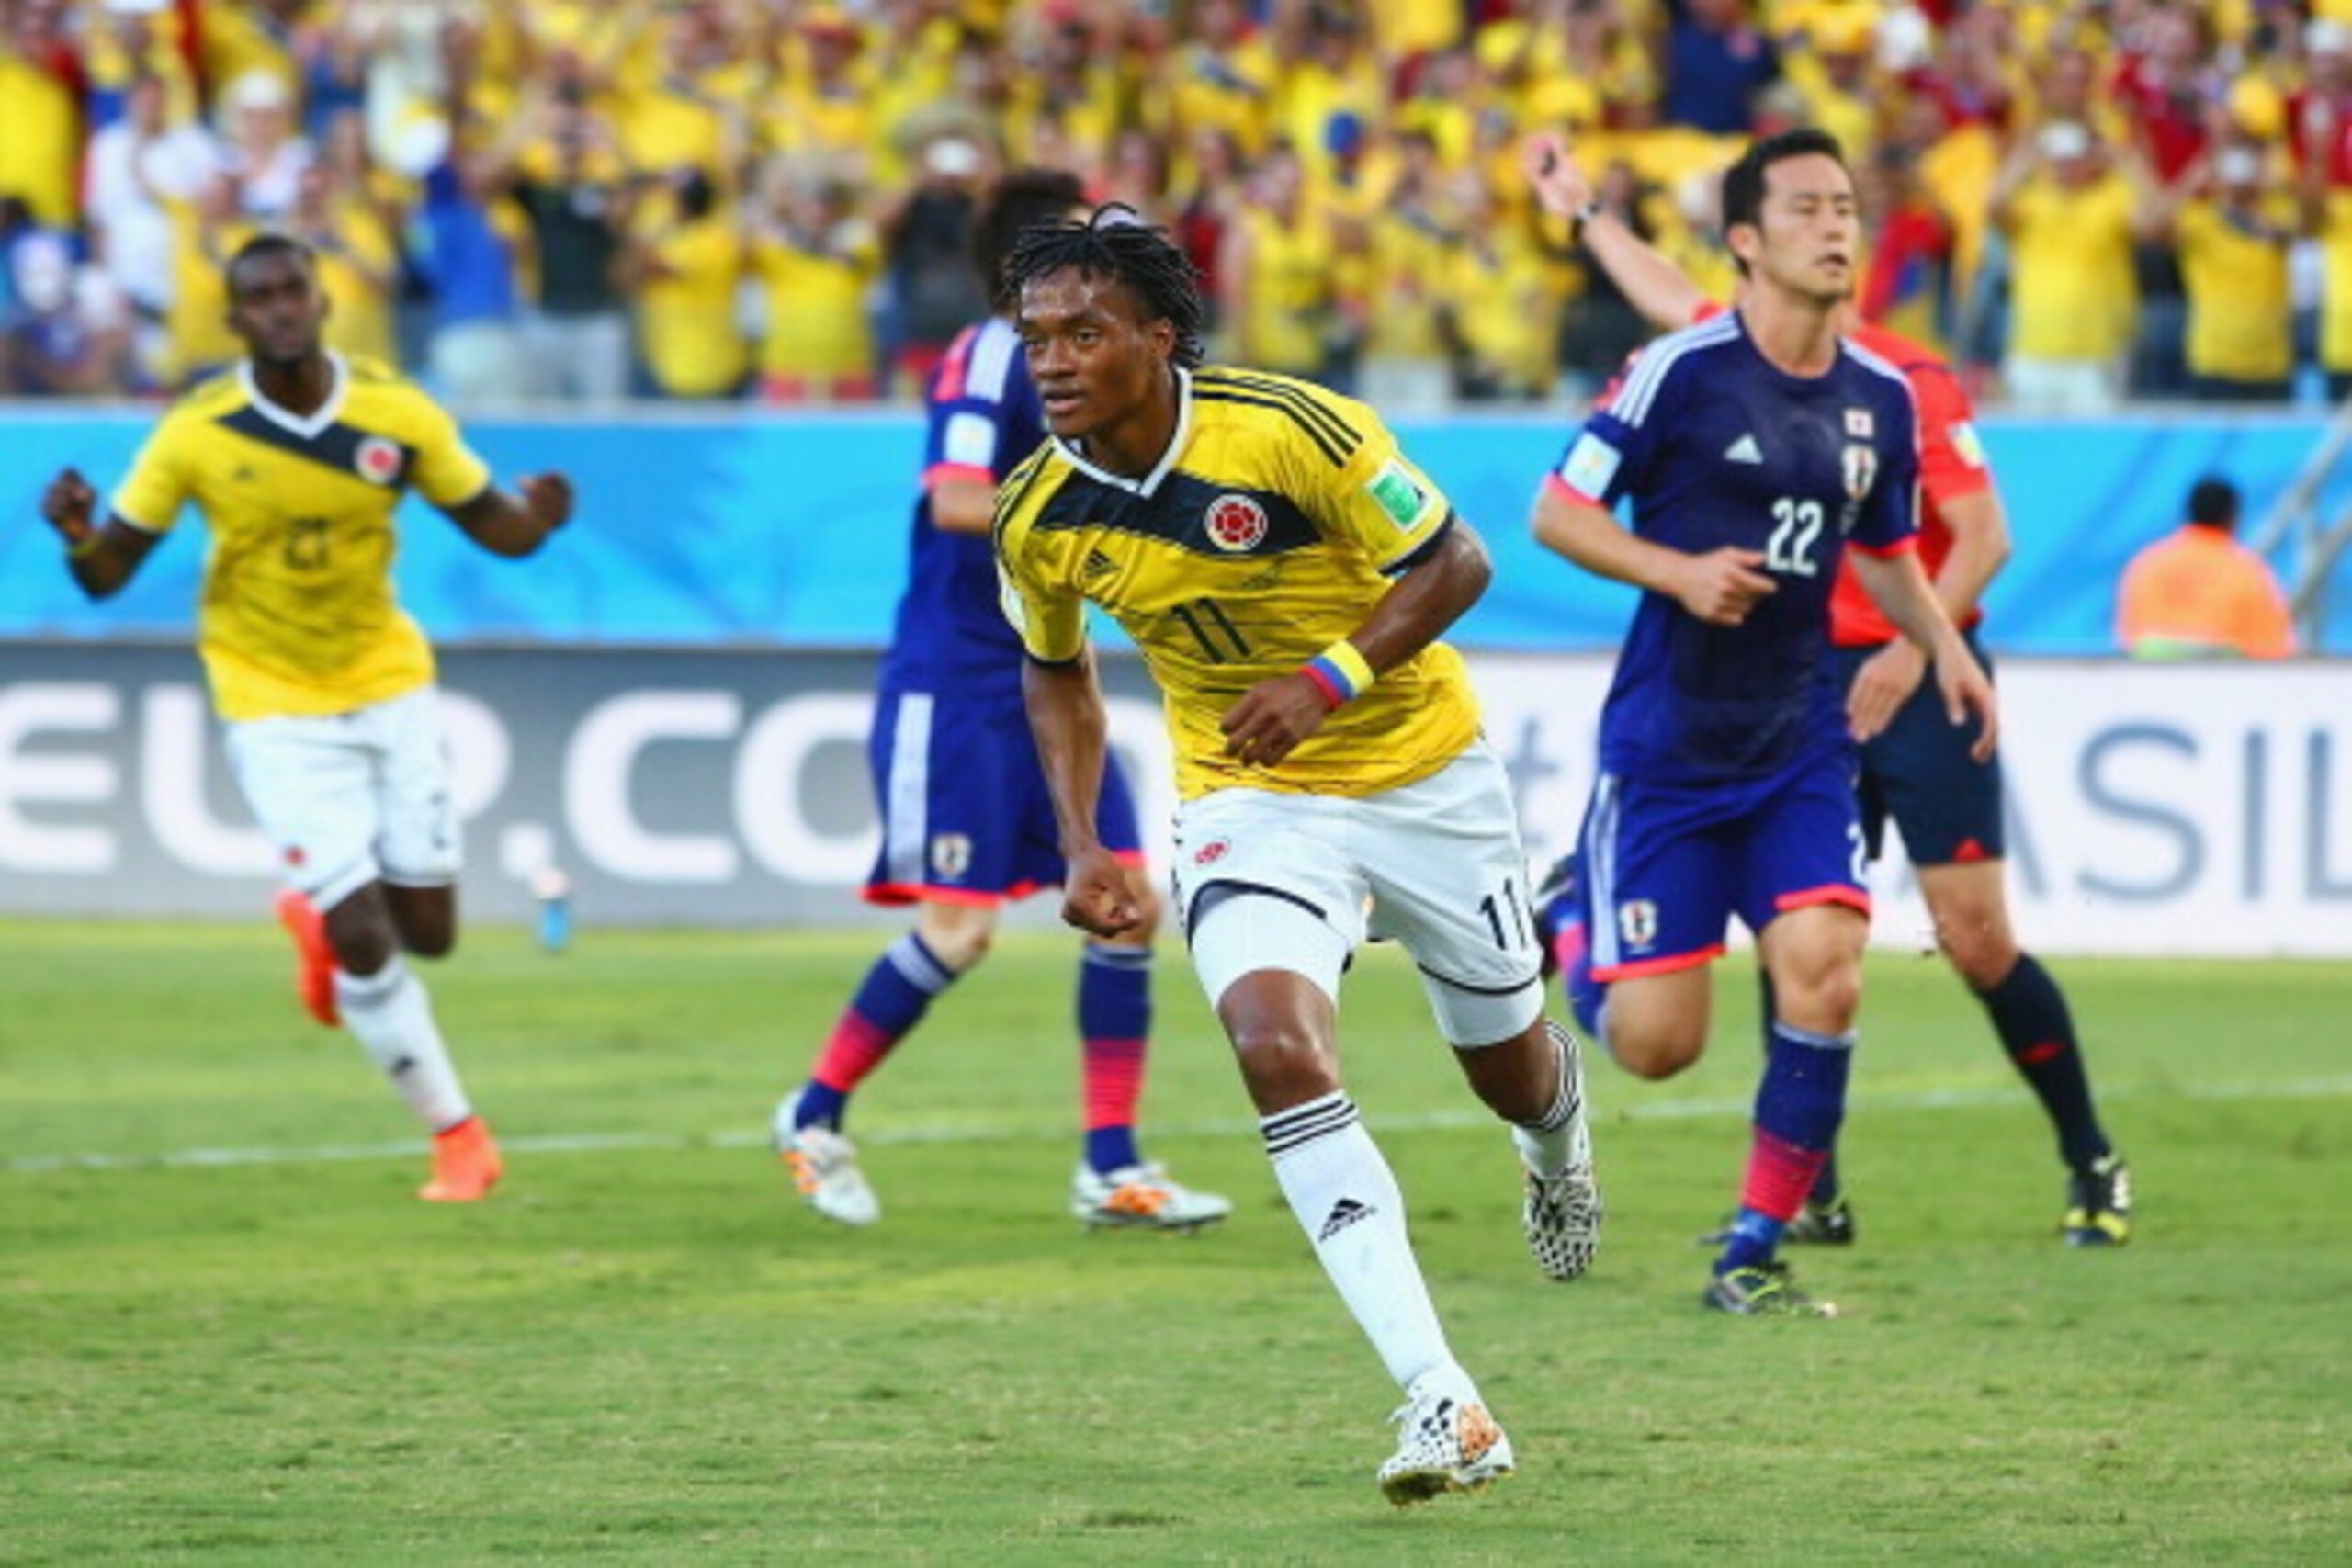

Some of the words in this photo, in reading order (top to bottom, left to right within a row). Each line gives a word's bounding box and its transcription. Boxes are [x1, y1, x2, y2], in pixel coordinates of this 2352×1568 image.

[1766, 497, 1825, 577] 22
[1172, 597, 1250, 664] 11
[1477, 877, 1528, 952] 11
